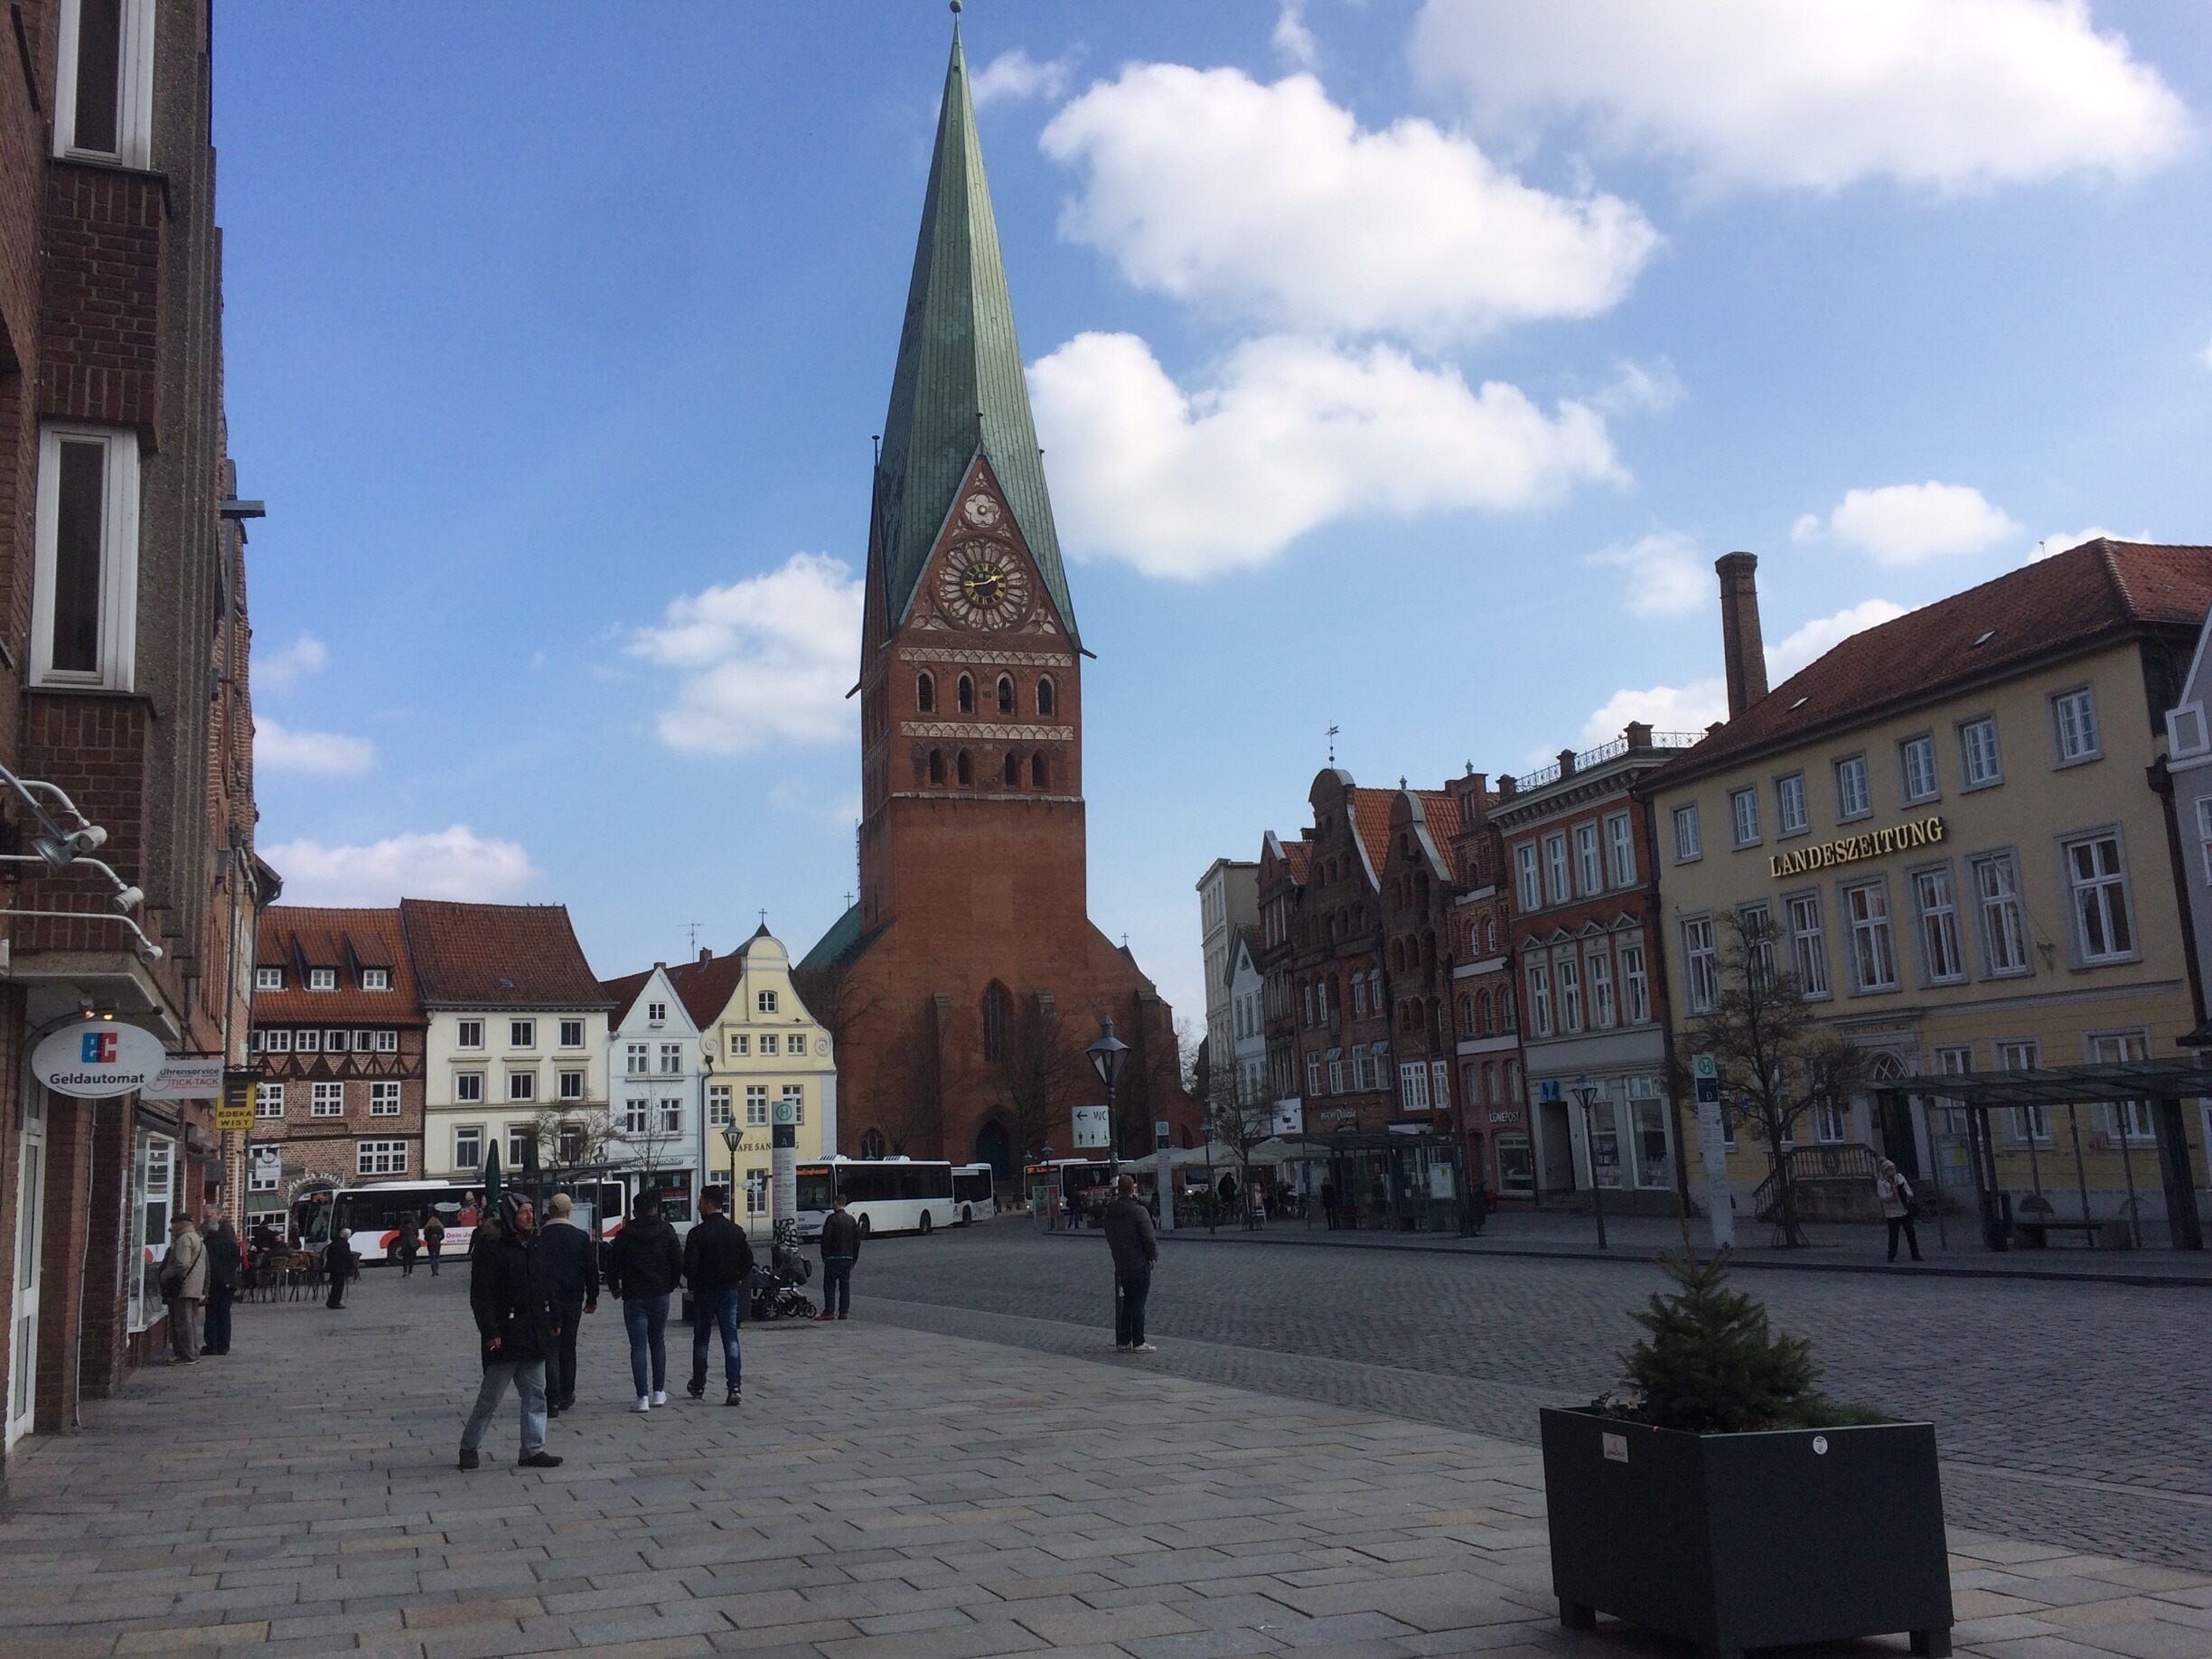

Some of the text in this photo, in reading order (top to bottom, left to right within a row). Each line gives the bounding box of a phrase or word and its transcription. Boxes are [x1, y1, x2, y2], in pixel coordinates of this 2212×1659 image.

[1768, 816, 1943, 877] LANDESZEITUNG
[160, 1067, 220, 1076] Uhrenservice
[50, 1073, 145, 1085] Geldautomat
[172, 1077, 219, 1086] TICK-TACK
[1092, 1110, 1107, 1121] WC
